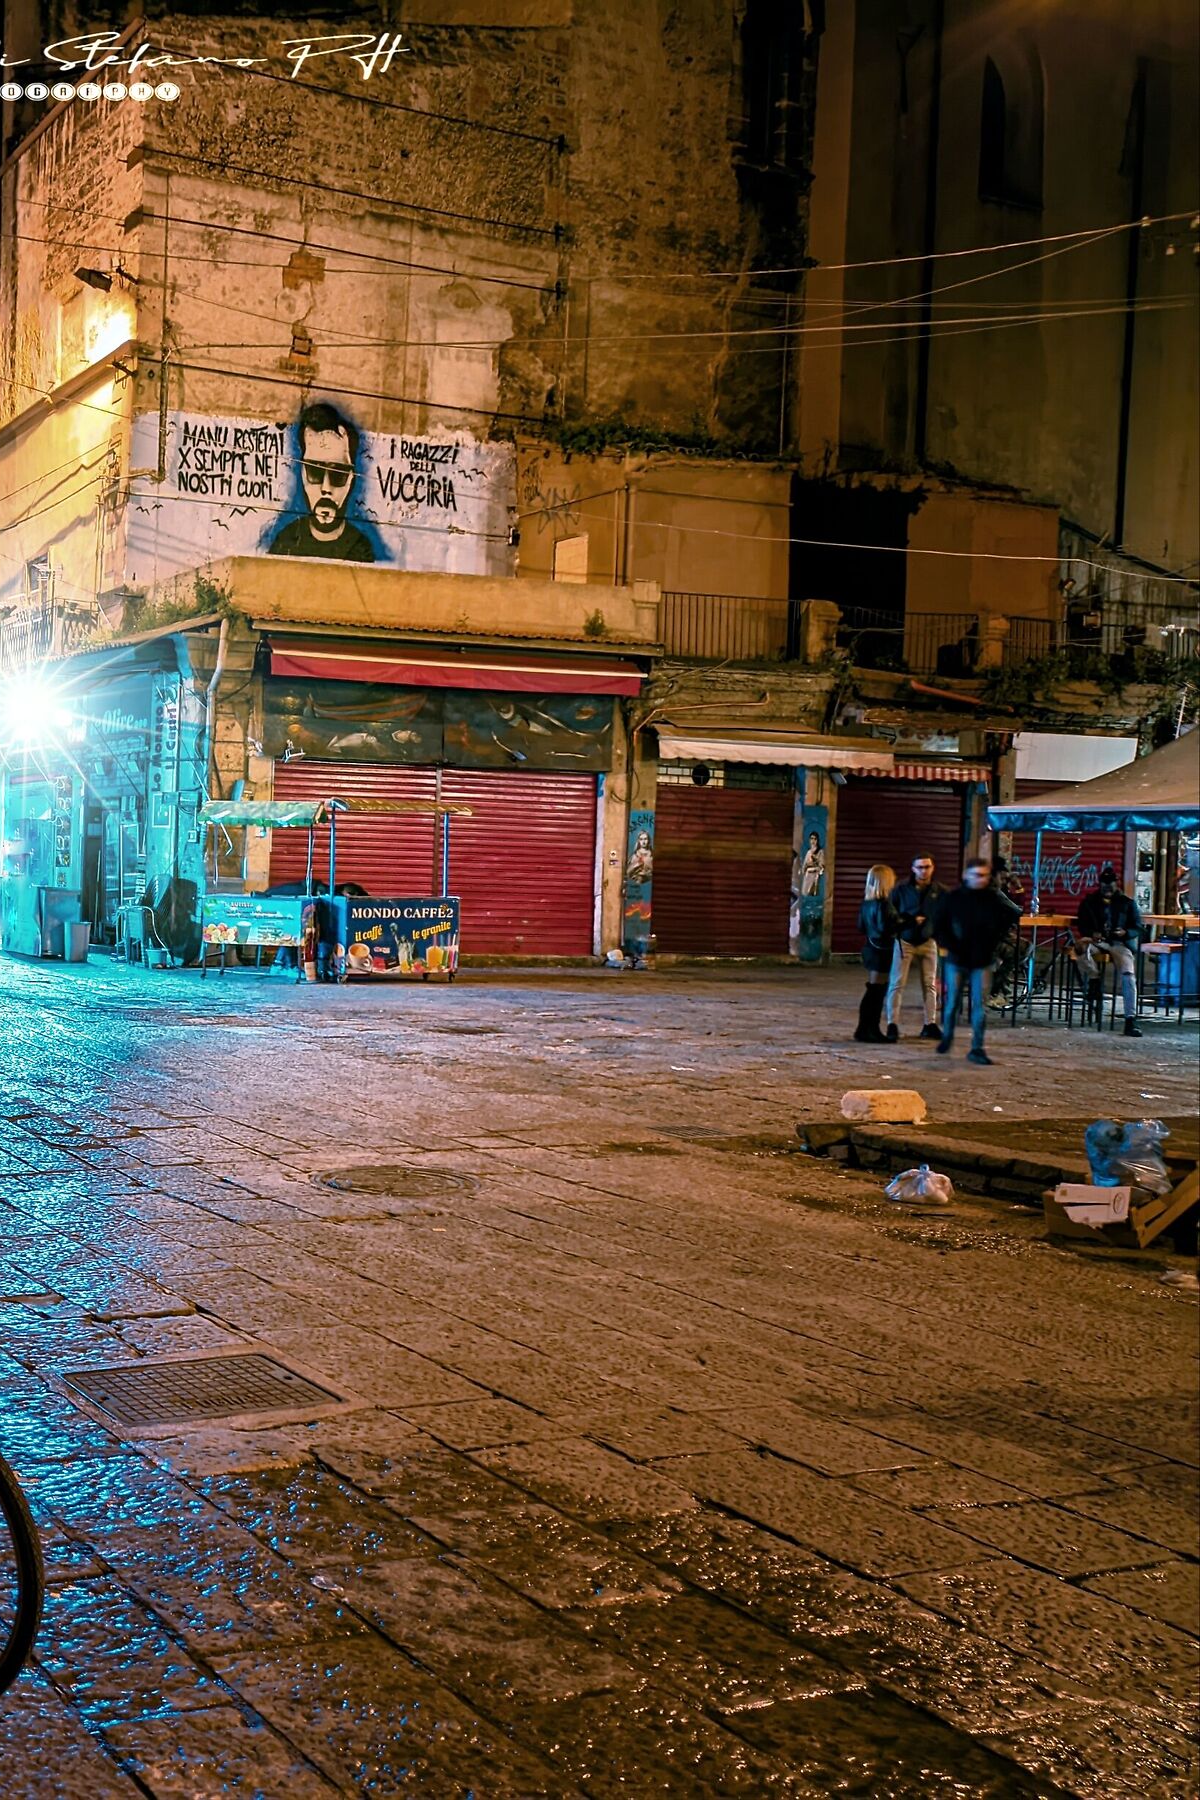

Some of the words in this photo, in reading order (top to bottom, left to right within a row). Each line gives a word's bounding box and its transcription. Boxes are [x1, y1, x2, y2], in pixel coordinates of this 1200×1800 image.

[182, 421, 228, 447] MANU
[178, 447, 191, 469] X
[409, 461, 436, 474] DELLA
[351, 907, 401, 919] MONDO
[355, 931, 362, 942] il
[412, 929, 421, 940] le
[421, 921, 451, 940] granite
